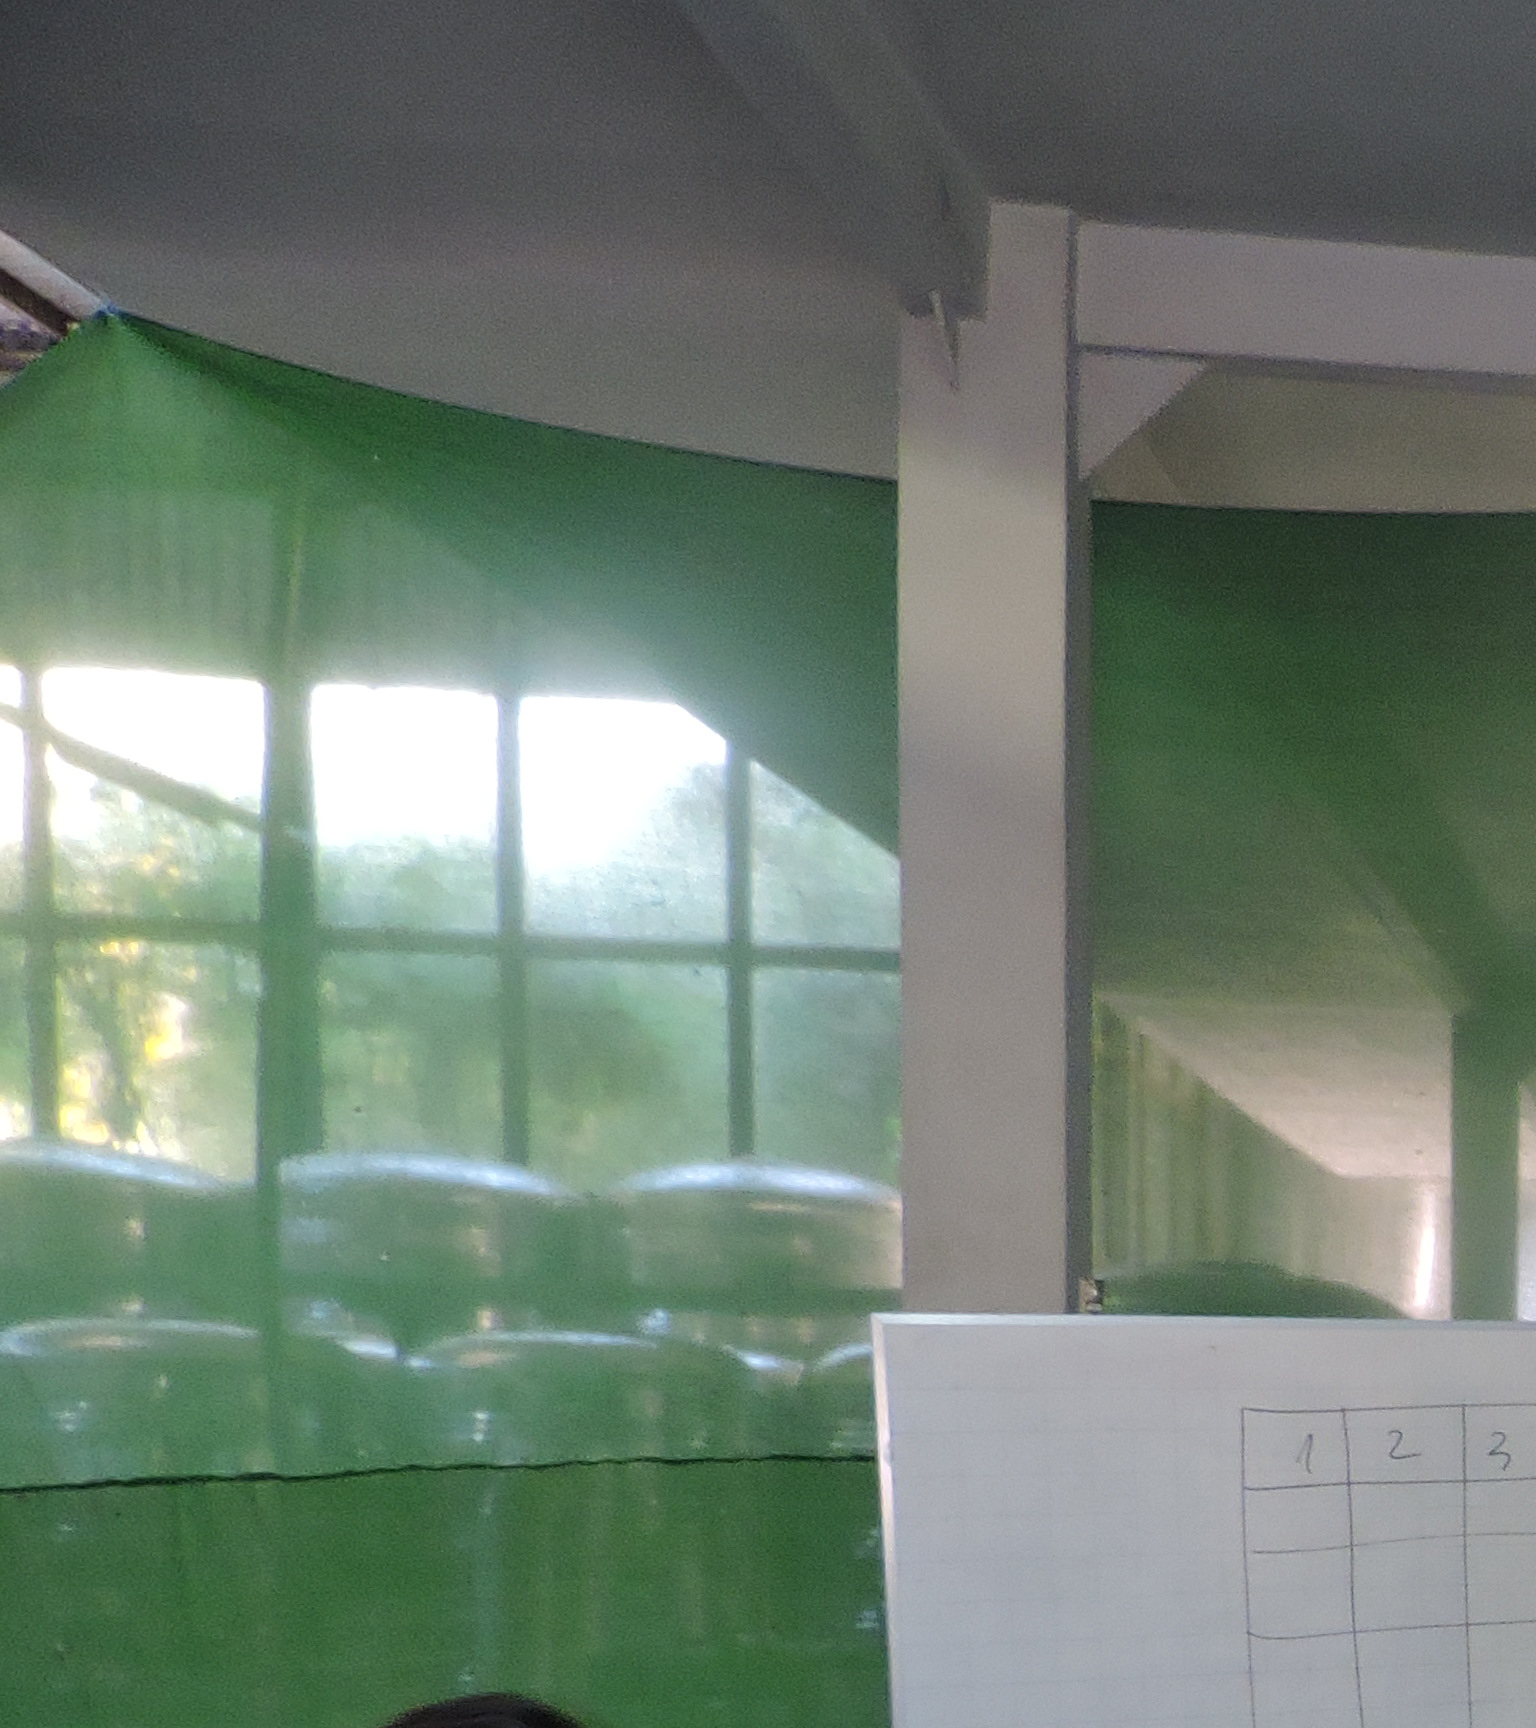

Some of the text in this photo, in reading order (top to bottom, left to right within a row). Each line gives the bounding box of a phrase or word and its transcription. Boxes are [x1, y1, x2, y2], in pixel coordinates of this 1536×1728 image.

[1294, 1431, 1316, 1475] 1
[1388, 1429, 1422, 1462] 2
[1487, 1431, 1513, 1471] 3
